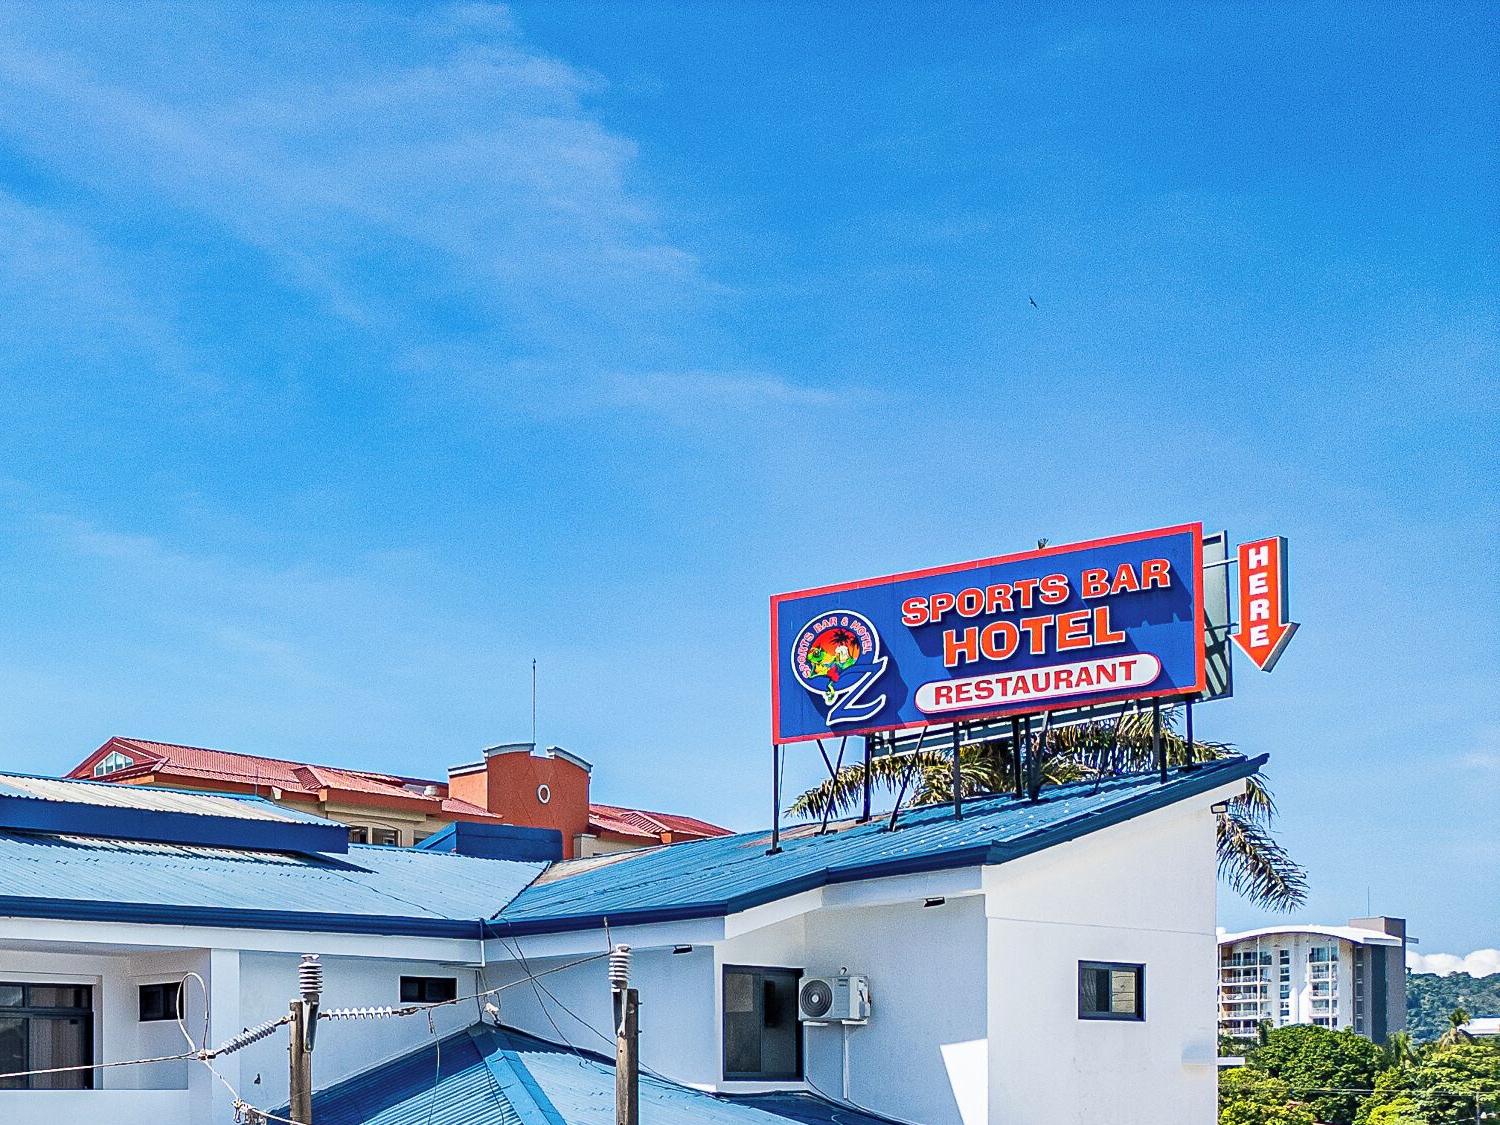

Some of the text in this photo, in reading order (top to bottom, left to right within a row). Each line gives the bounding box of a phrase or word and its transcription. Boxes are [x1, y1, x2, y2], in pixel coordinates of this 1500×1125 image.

[901, 558, 1171, 628] SPORTS BAR
[1248, 545, 1270, 648] HERE
[797, 632, 814, 678] SPORTS
[813, 617, 838, 633] BAR
[850, 620, 872, 655] HOTEL
[943, 606, 1126, 667] HOTEL
[933, 659, 1140, 706] RESTAURANT
